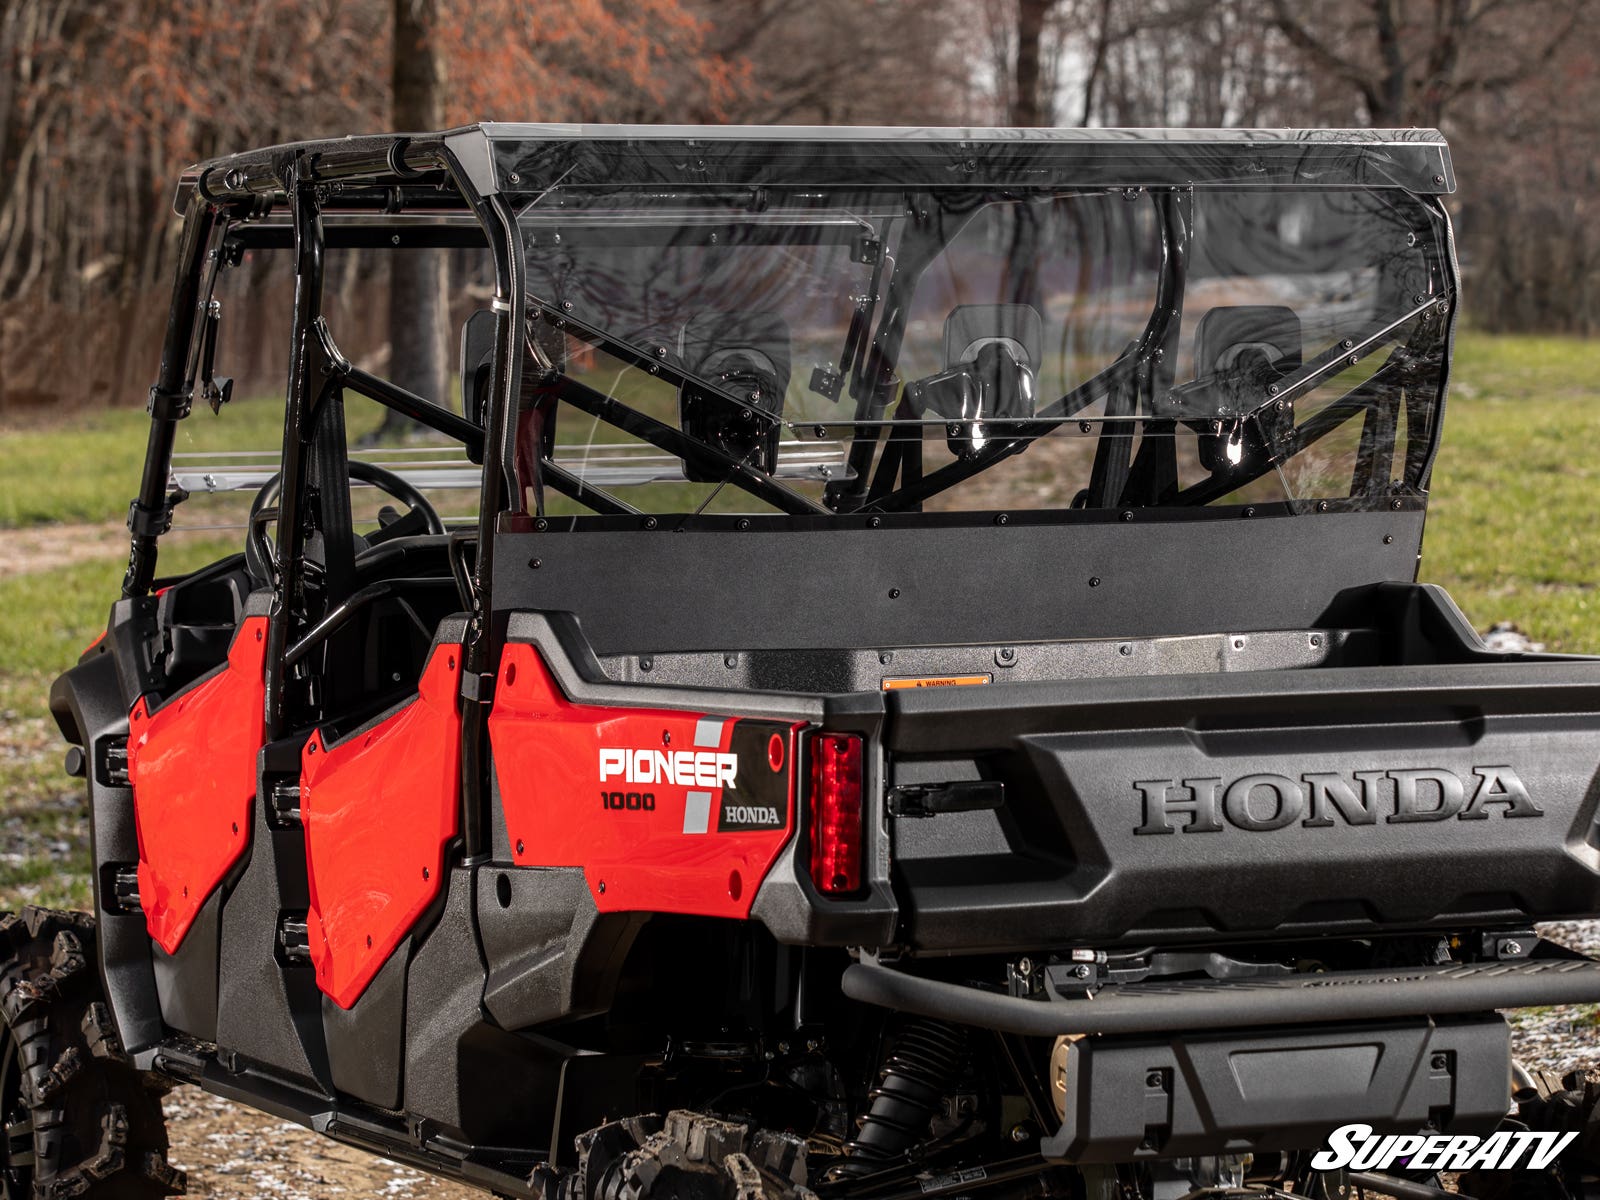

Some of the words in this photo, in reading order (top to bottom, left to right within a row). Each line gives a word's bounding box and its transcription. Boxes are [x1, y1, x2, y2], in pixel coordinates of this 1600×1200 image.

[600, 748, 738, 789] PIONEER
[601, 791, 656, 811] 1000
[725, 806, 780, 824] HONDA
[1132, 765, 1545, 836] HONDA
